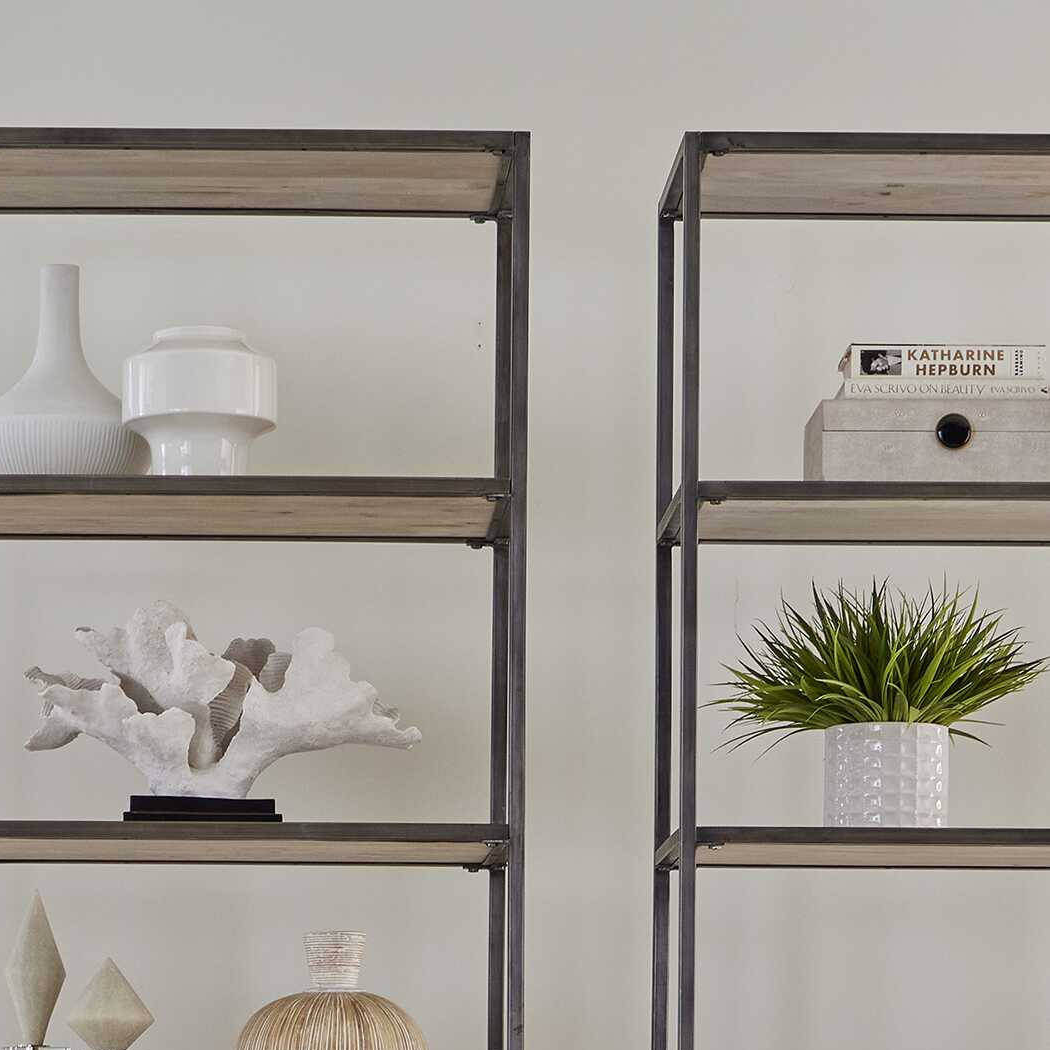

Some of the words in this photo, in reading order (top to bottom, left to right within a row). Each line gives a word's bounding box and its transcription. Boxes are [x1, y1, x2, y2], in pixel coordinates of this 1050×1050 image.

[907, 350, 1005, 361] KATHARINE
[915, 364, 996, 376] HEPBURN
[850, 384, 872, 394] EVA
[873, 384, 917, 394] SCRIVO
[919, 384, 938, 394] ON
[940, 384, 987, 395] BEAUTY
